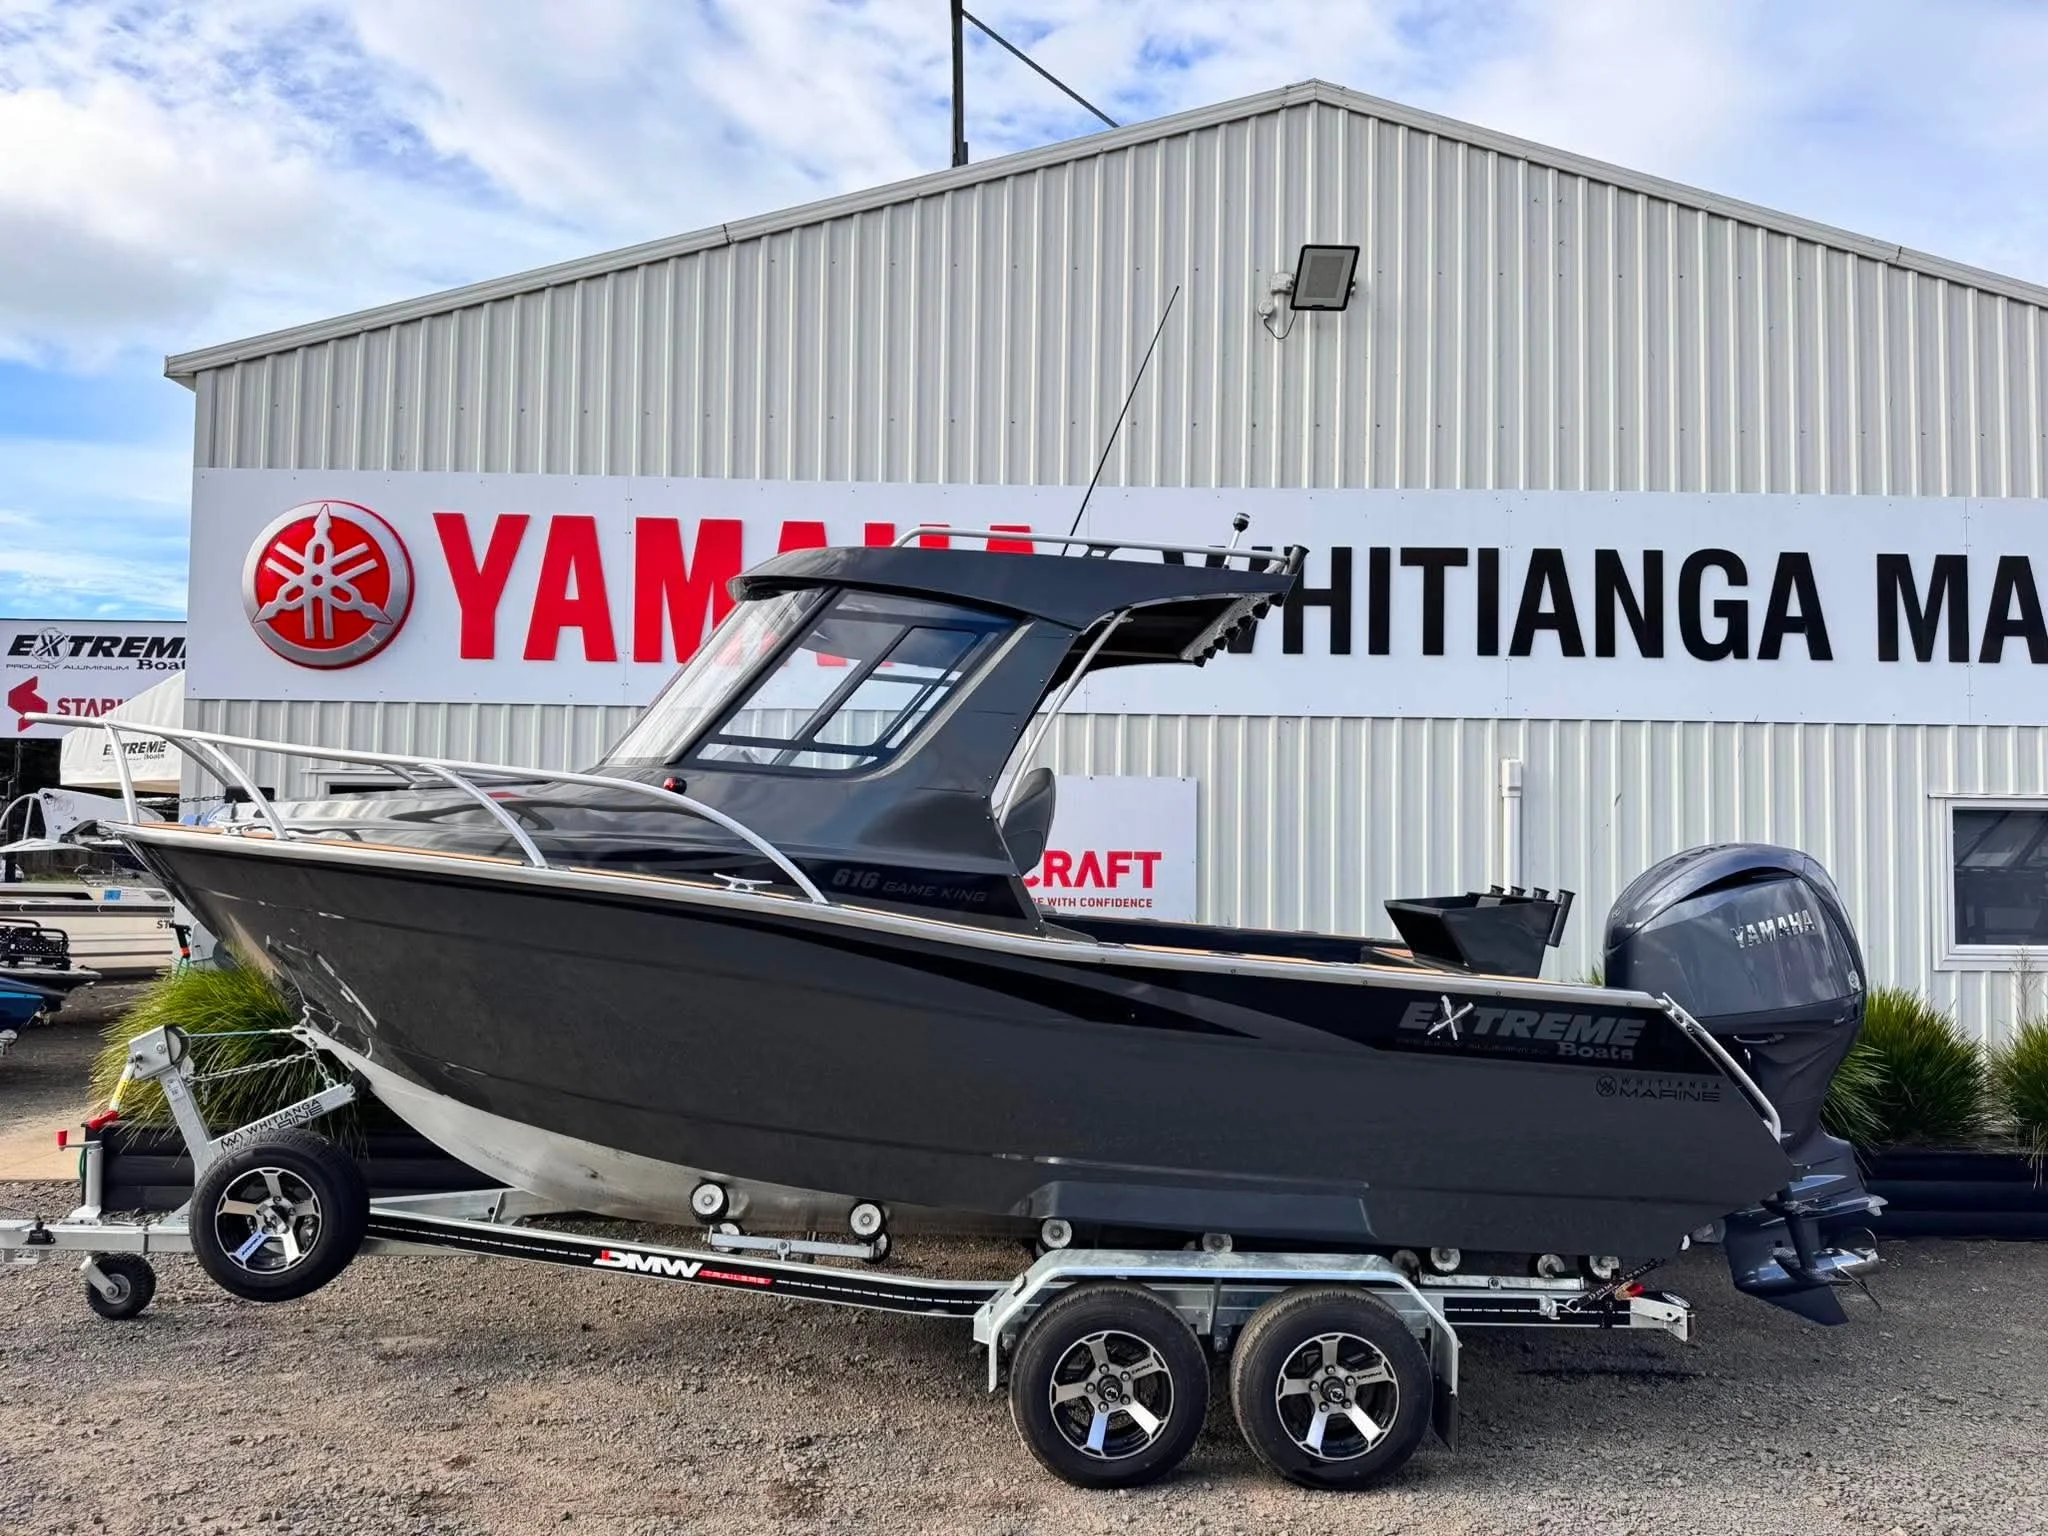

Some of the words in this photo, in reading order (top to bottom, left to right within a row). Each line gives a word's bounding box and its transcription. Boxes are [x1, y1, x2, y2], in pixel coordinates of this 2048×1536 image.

[432, 512, 1035, 665] YAM
[7, 630, 186, 660] EXTREM
[6, 663, 60, 671] PROUDLY
[103, 740, 167, 756] ETREME
[831, 868, 881, 889] 616
[881, 881, 938, 898] GAME
[940, 886, 988, 903] KING
[1047, 897, 1076, 907] WITH
[1080, 897, 1153, 908] CONFIDENCE
[1730, 909, 1816, 949] YAMAHA
[1399, 996, 1647, 1047] EXTREME
[1556, 1041, 1635, 1062] Boats
[1620, 1087, 1721, 1102] MARINE
[246, 1098, 320, 1135] WHITIANGA
[592, 1249, 704, 1279] DMW
